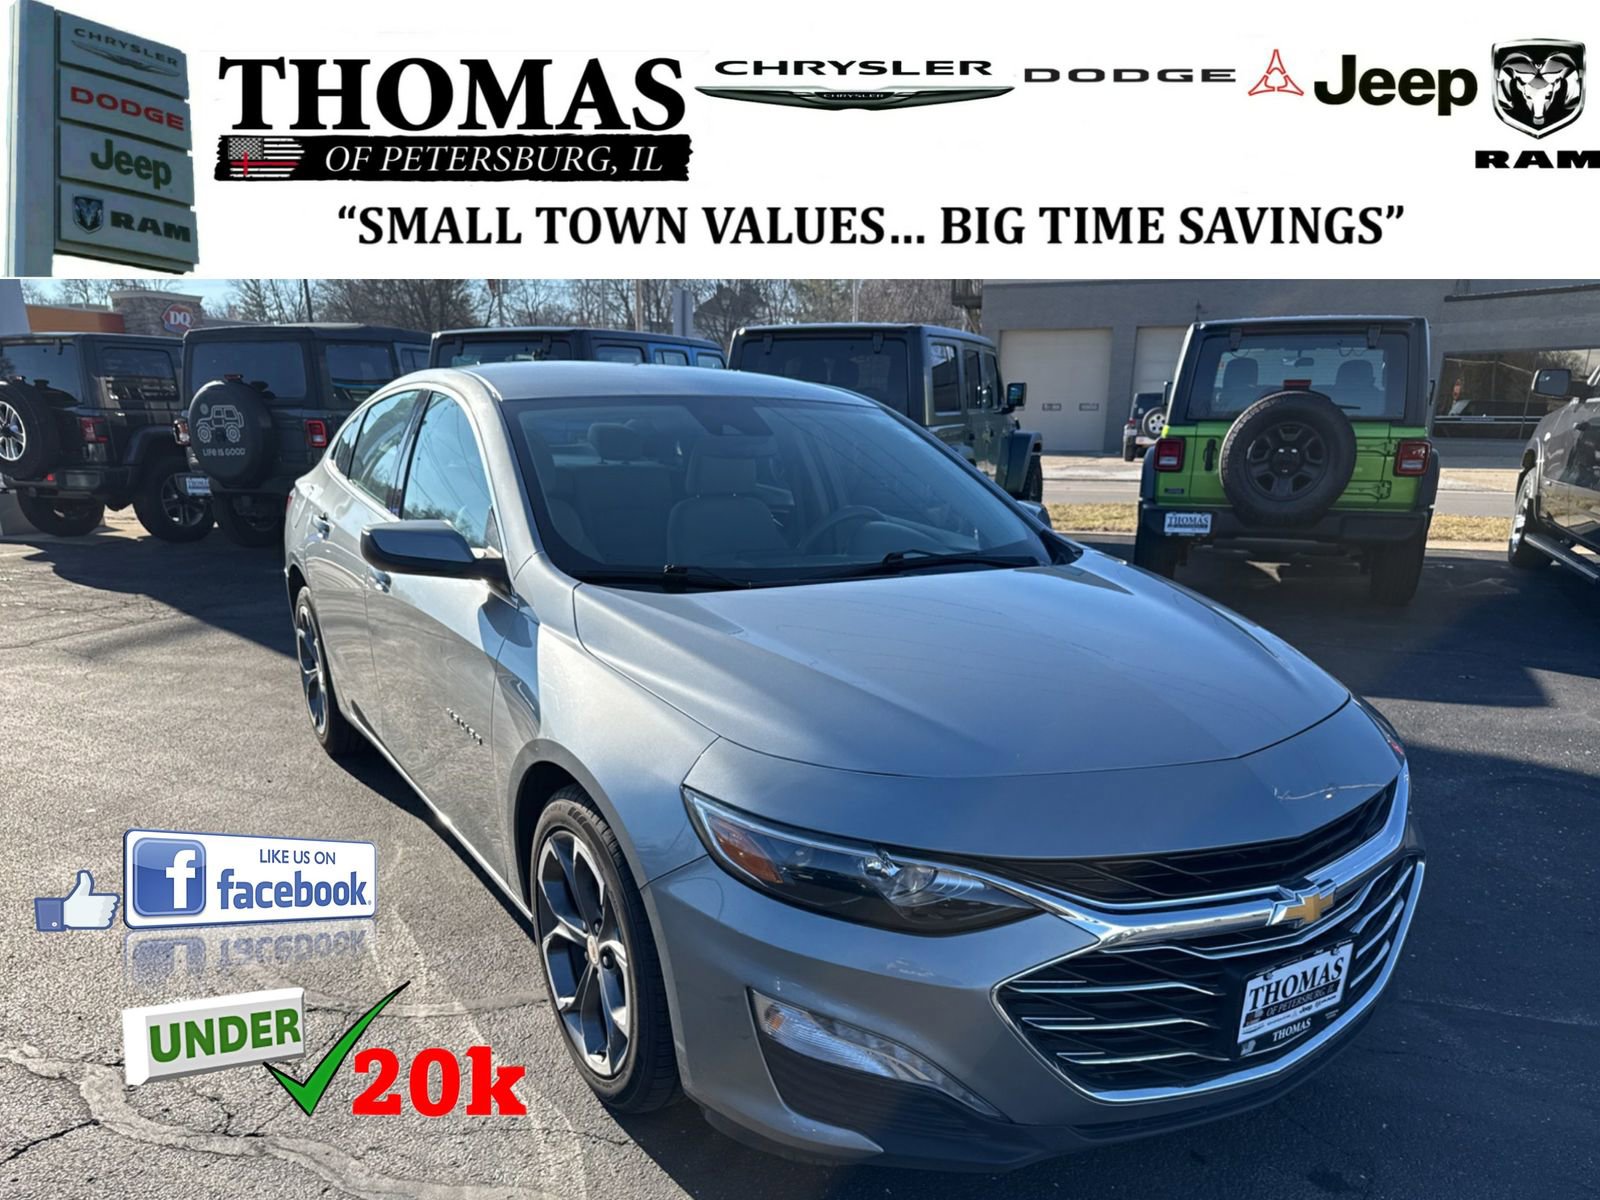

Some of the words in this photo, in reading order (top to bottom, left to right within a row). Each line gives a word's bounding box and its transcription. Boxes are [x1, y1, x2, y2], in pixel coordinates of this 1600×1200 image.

[169, 311, 191, 328] DQ
[1167, 515, 1209, 526] THOMAS
[1248, 956, 1344, 1012] THOMAS
[1272, 1017, 1312, 1042] THOMAS
